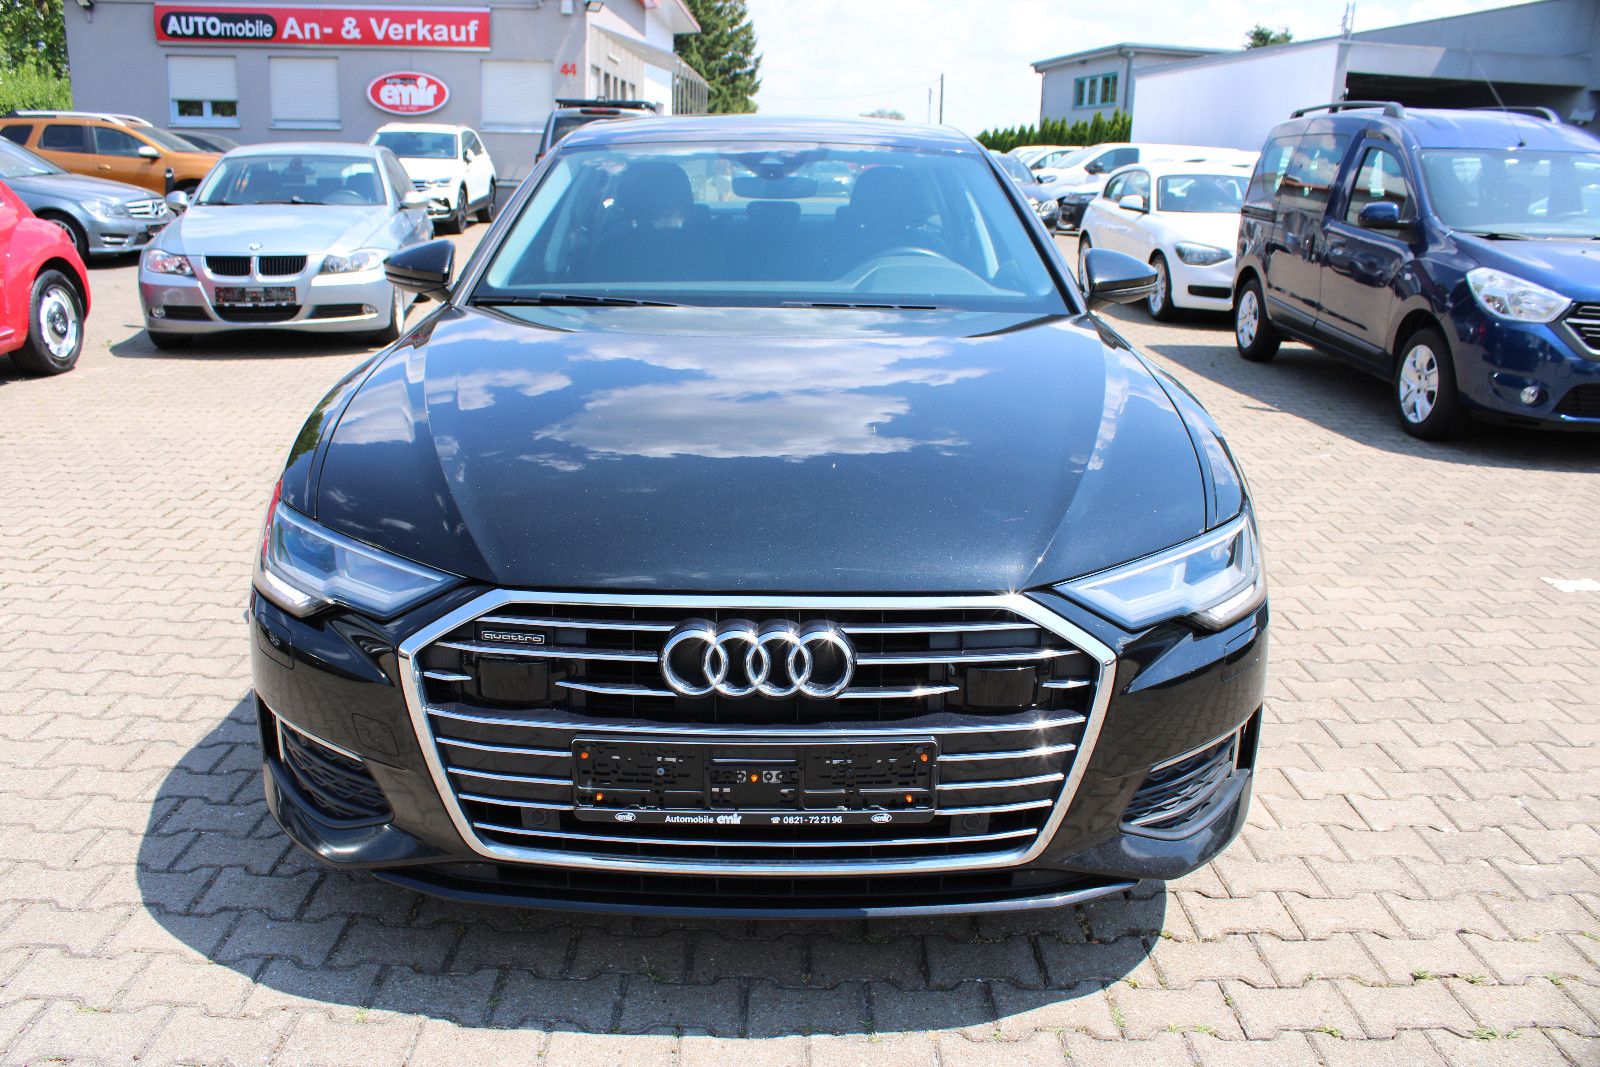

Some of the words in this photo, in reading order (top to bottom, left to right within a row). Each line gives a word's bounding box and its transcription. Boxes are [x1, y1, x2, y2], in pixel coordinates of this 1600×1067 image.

[167, 15, 273, 38] AUTOmobile
[282, 16, 333, 40] An-
[341, 16, 362, 40] &
[369, 17, 479, 42] Verkauf
[560, 63, 577, 77] 44
[379, 76, 438, 106] emir
[484, 633, 543, 643] quattro
[664, 815, 714, 824] Automobile
[716, 812, 742, 825] emir
